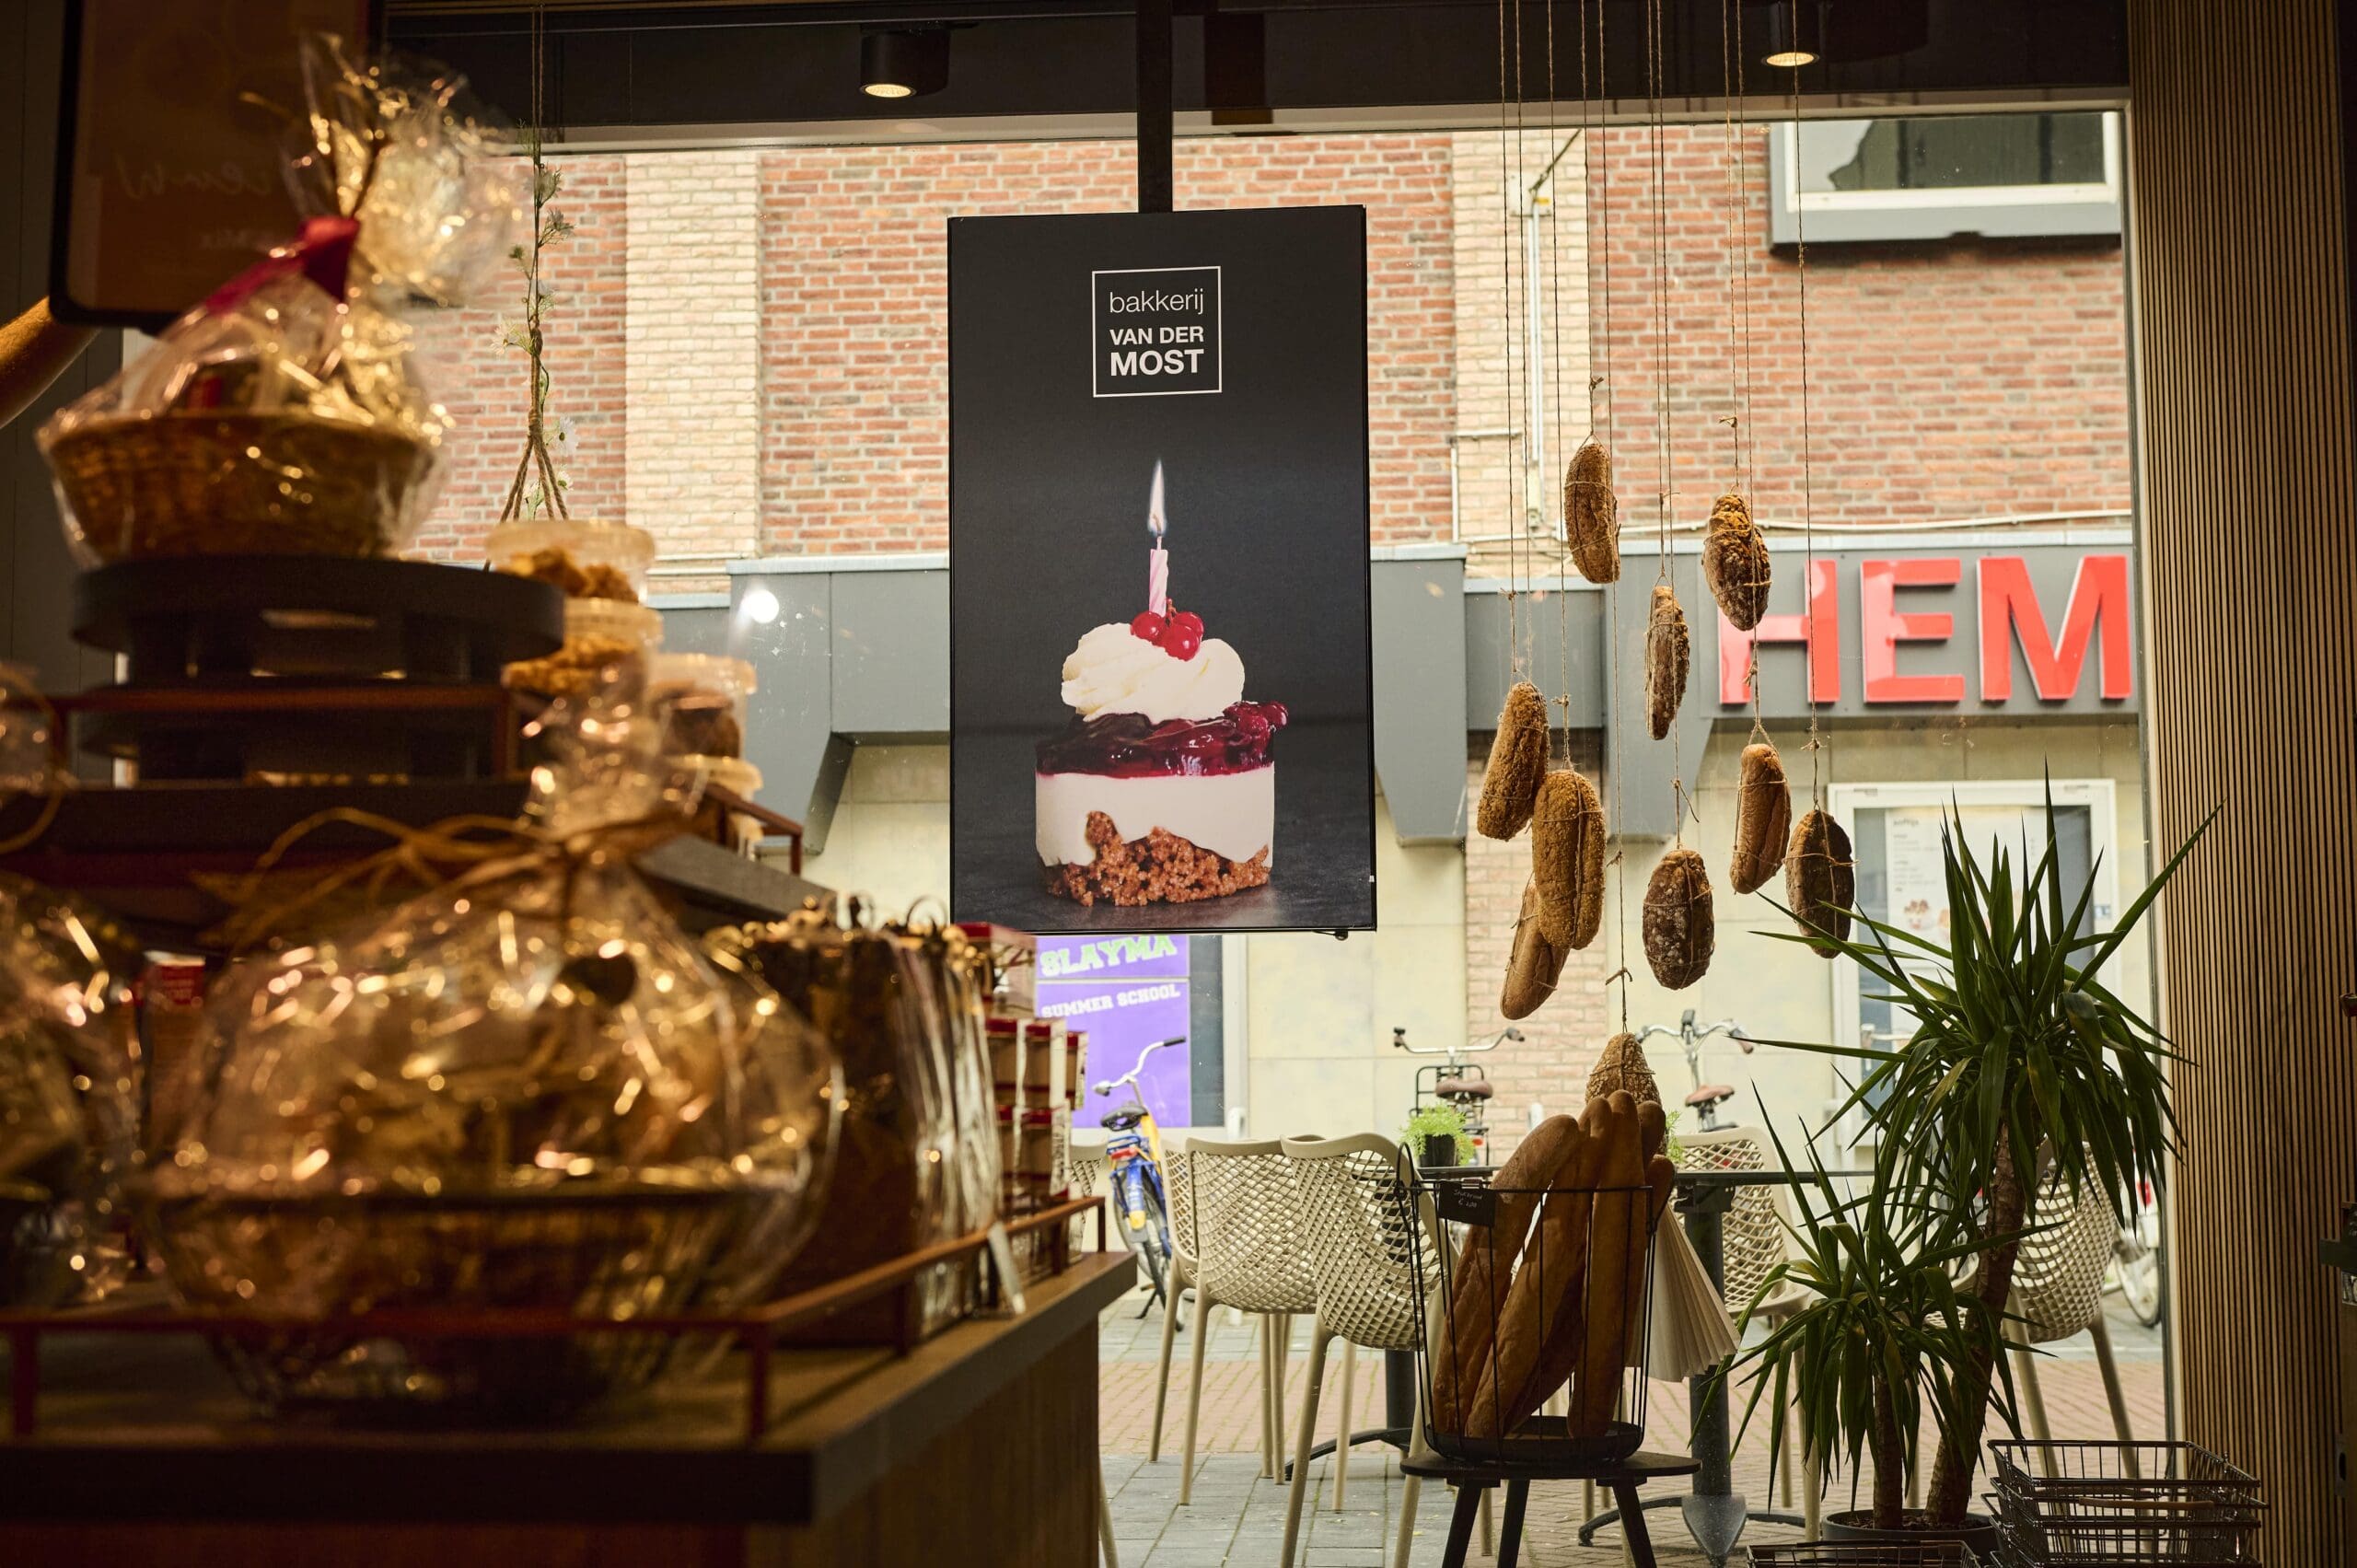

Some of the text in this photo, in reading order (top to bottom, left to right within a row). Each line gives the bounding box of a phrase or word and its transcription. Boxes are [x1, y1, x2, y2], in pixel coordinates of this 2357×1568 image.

[1109, 288, 1203, 315] bakkerij
[1109, 326, 1204, 345] VAN DER
[1110, 349, 1204, 377] MOST
[1717, 555, 2132, 703] HEM
[1041, 983, 1180, 1018] SUMMER SCHOOL
